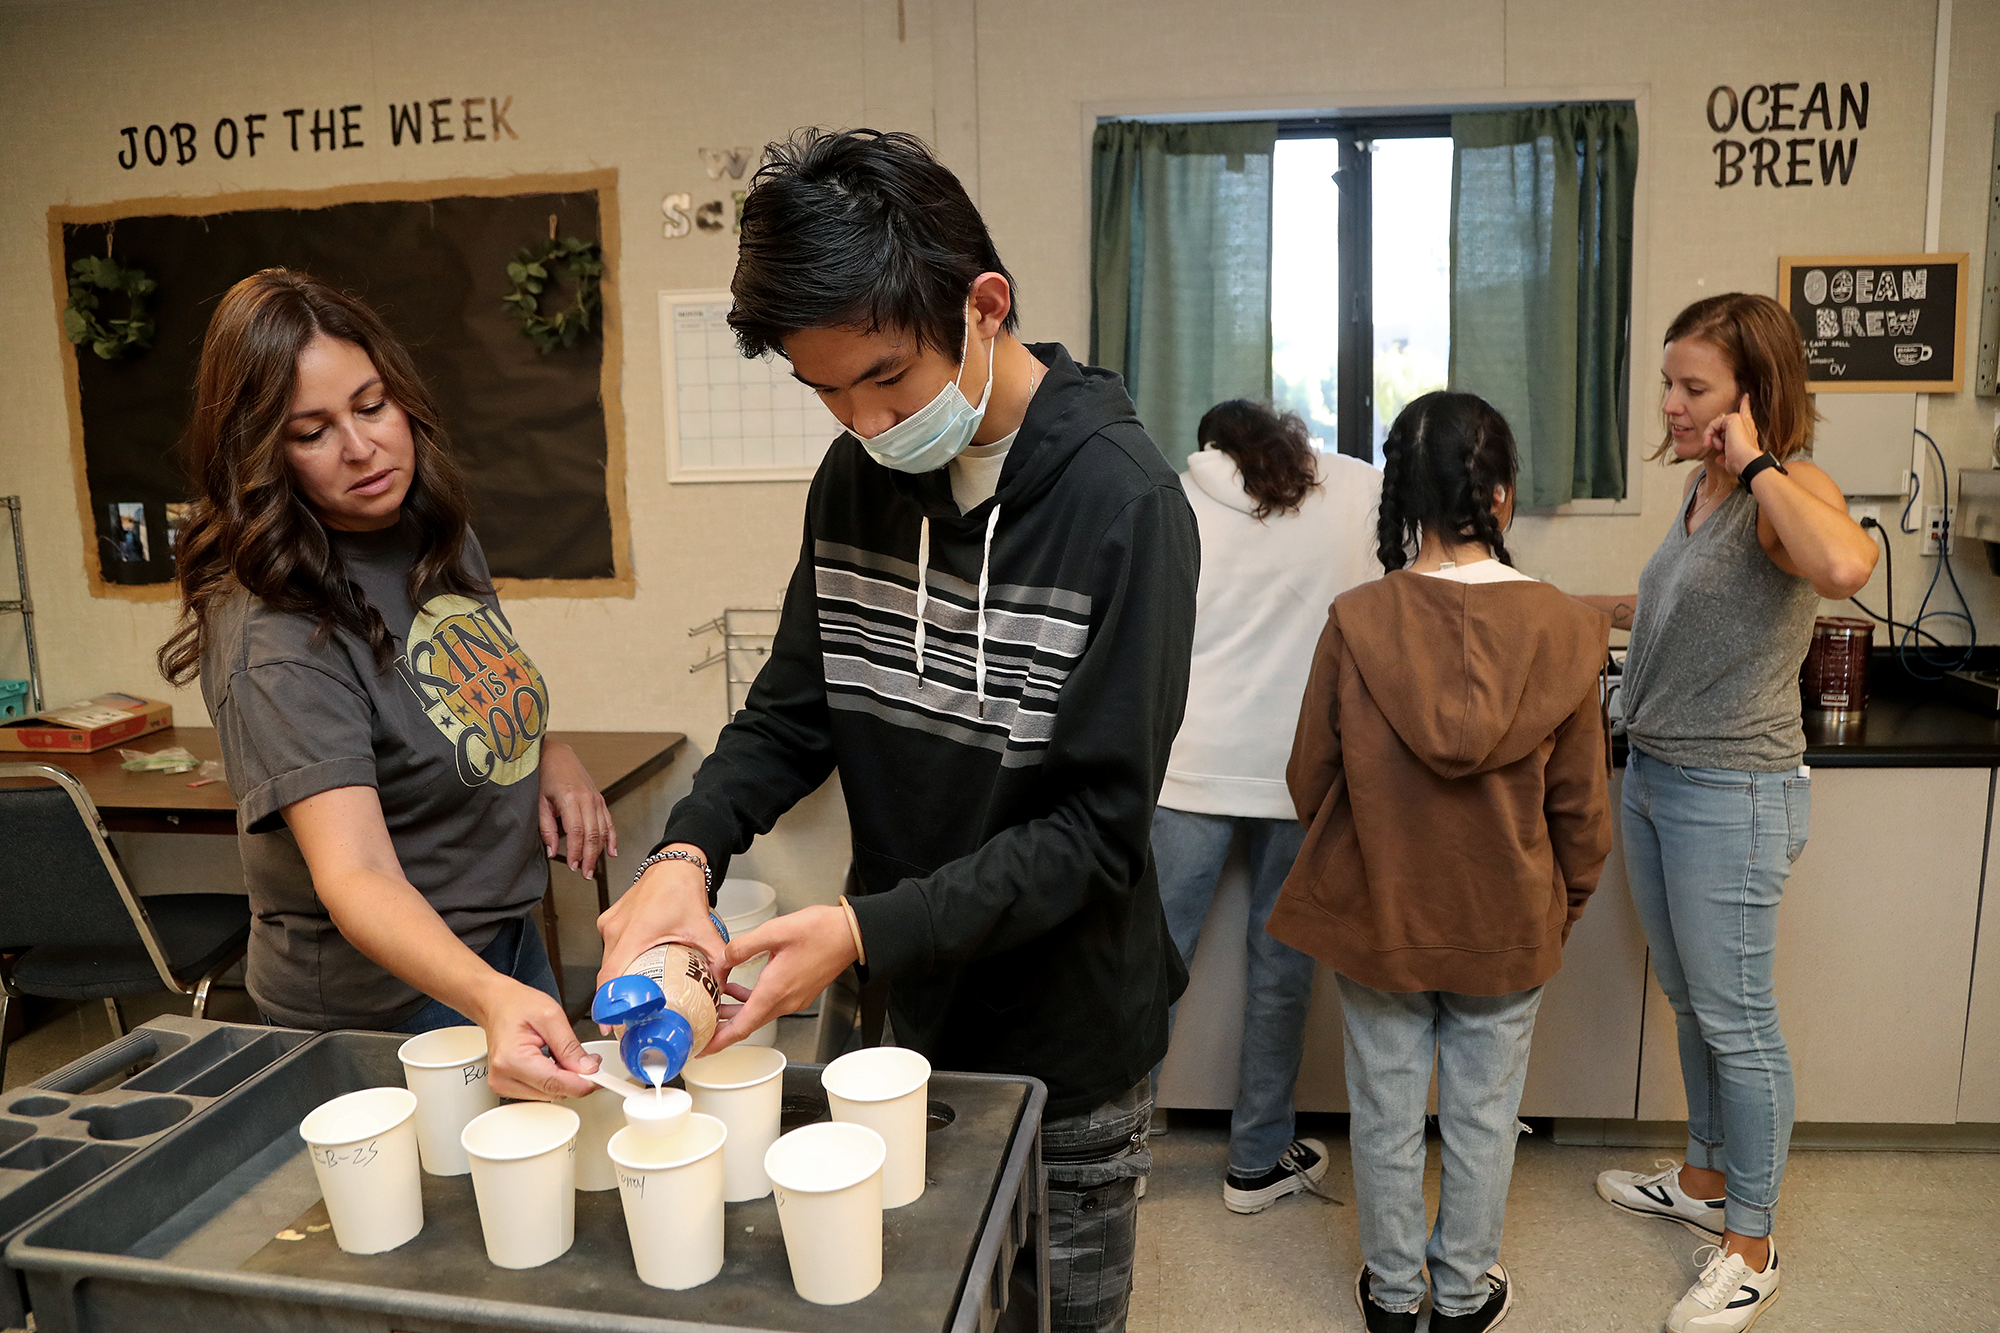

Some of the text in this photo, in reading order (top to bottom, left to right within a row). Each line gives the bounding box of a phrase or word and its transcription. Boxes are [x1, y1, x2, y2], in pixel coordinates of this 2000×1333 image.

[1706, 81, 1869, 134] OCEAN
[118, 95, 519, 170] JOB OF THE WEEK
[1712, 137, 1858, 188] BREW
[1803, 268, 1928, 306] OCEAN
[1816, 306, 1920, 339] BREW
[1829, 363, 1847, 376] OV
[478, 671, 508, 703] IS
